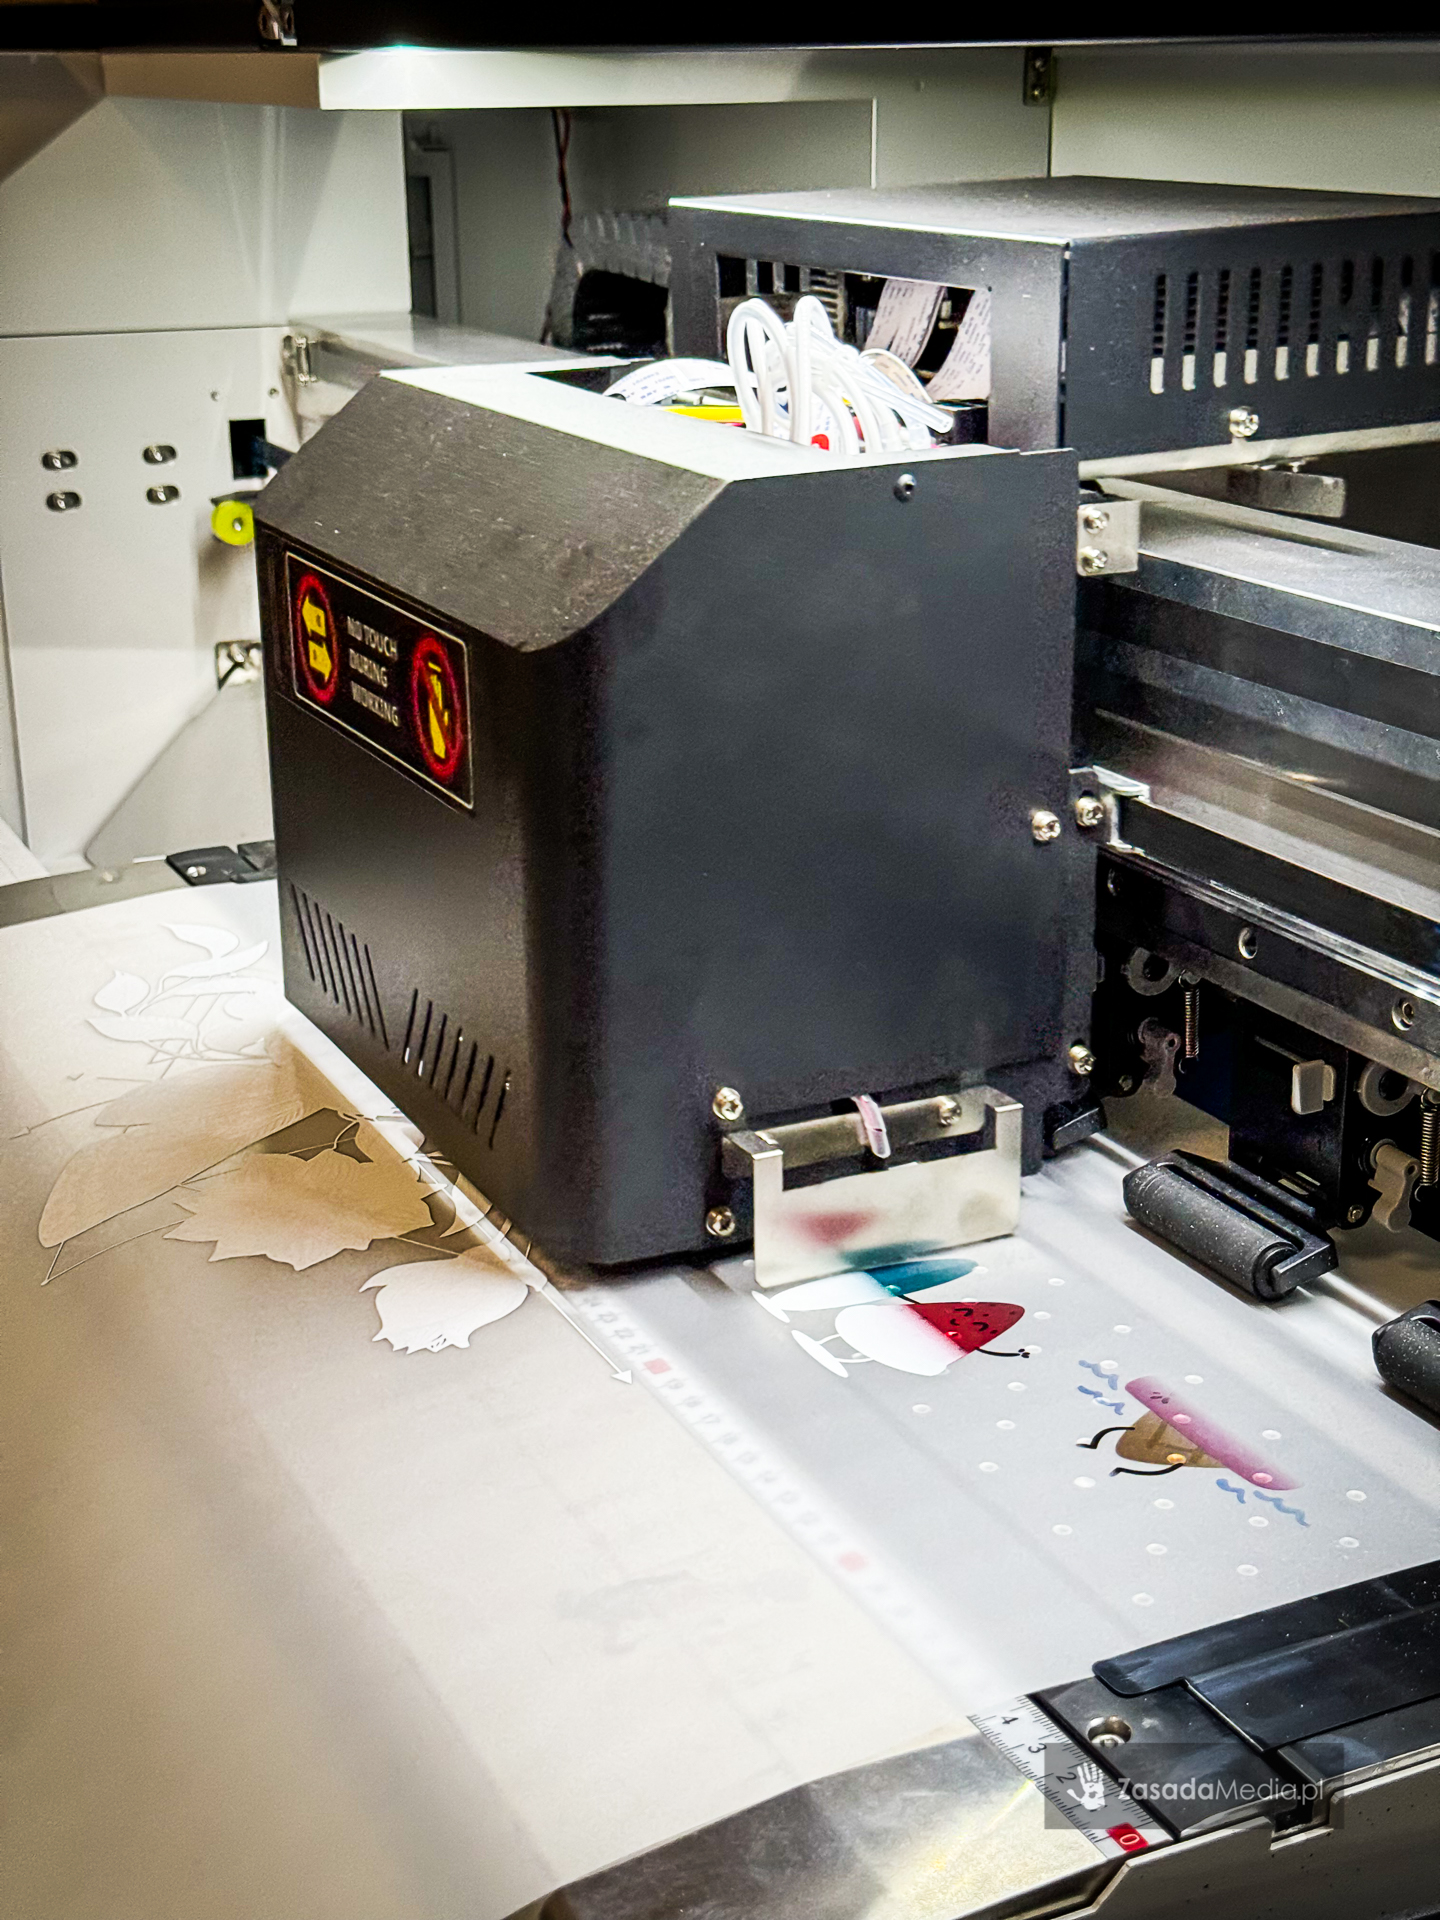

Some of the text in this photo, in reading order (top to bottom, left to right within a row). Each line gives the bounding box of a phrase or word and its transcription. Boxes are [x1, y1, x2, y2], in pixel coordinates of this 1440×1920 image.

[363, 624, 398, 660] TOUCH
[349, 648, 388, 688] DURING
[351, 680, 399, 727] WORKING
[1001, 1715, 1139, 1845] 4 3 2 0
